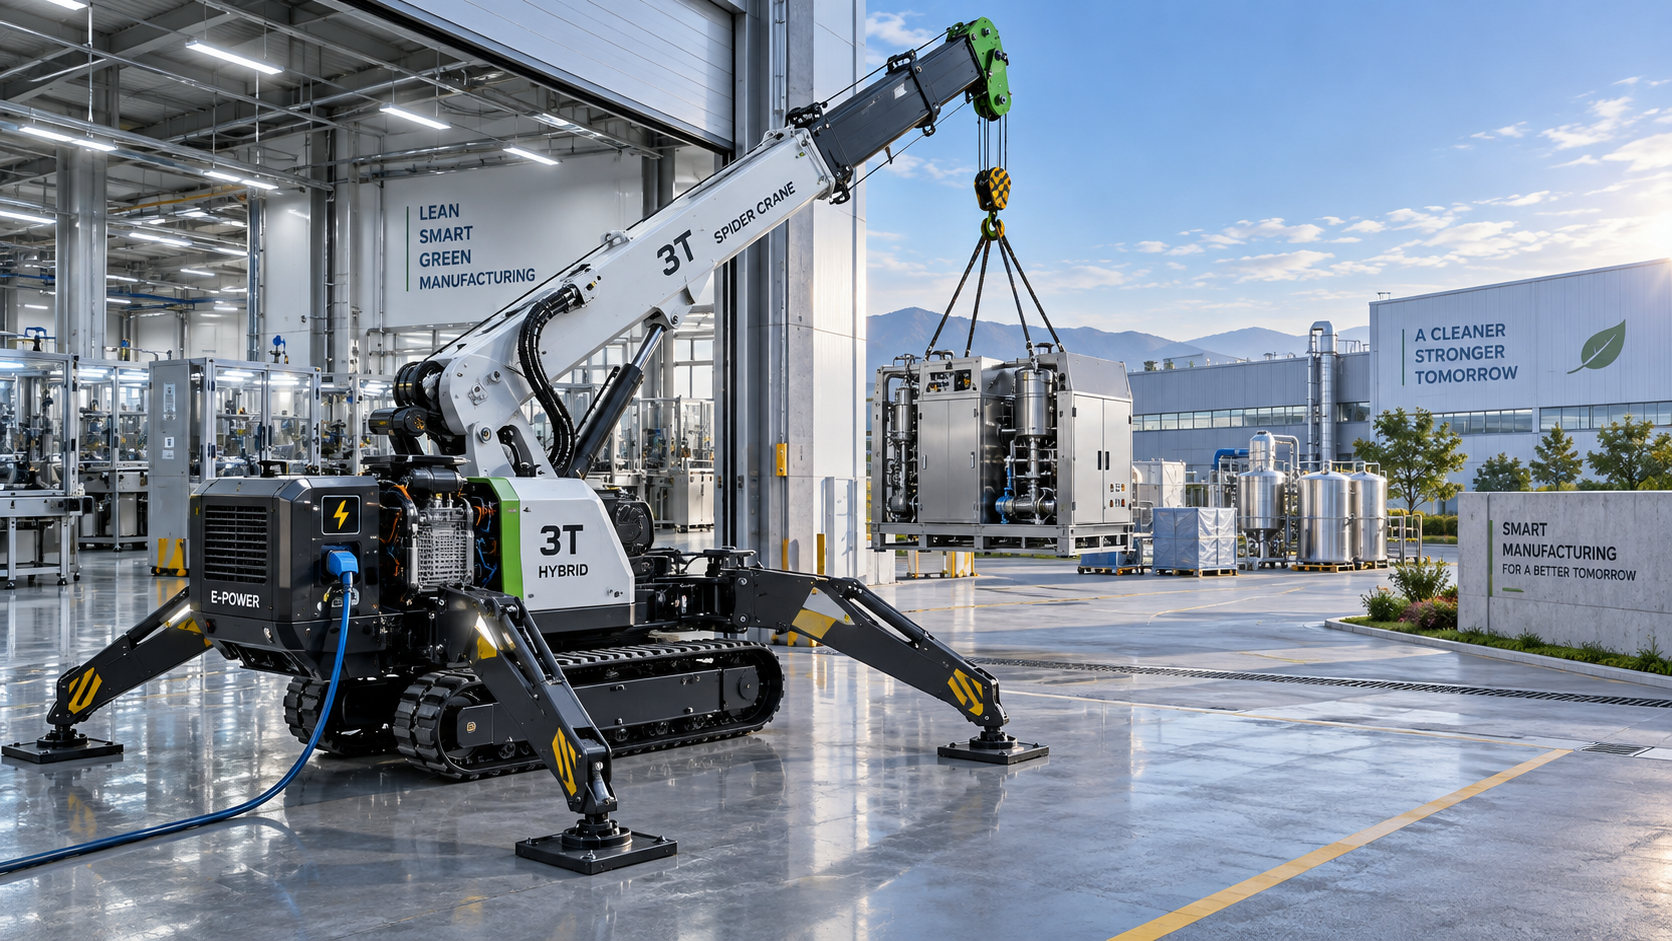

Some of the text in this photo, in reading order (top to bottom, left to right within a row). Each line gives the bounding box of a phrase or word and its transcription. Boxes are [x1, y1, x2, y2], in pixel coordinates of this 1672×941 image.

[420, 203, 459, 220] LEAN
[713, 181, 796, 244] SPIDER CRANE
[419, 225, 473, 244] SMART
[419, 249, 471, 267] GREEN
[656, 229, 694, 276] 3T
[419, 268, 536, 290] MANUFACTURING
[1415, 323, 1506, 342] A CLEANER
[1415, 344, 1505, 363] STRONGER
[1415, 365, 1518, 385] TOMORROW
[1502, 521, 1548, 537] SMART
[540, 524, 583, 556] 3T
[1502, 543, 1617, 561] MANUFACTURING
[538, 563, 589, 579] HYBRID
[1502, 563, 1637, 581] FOR A BETTER TOMORROW
[211, 590, 260, 608] E-POWER
